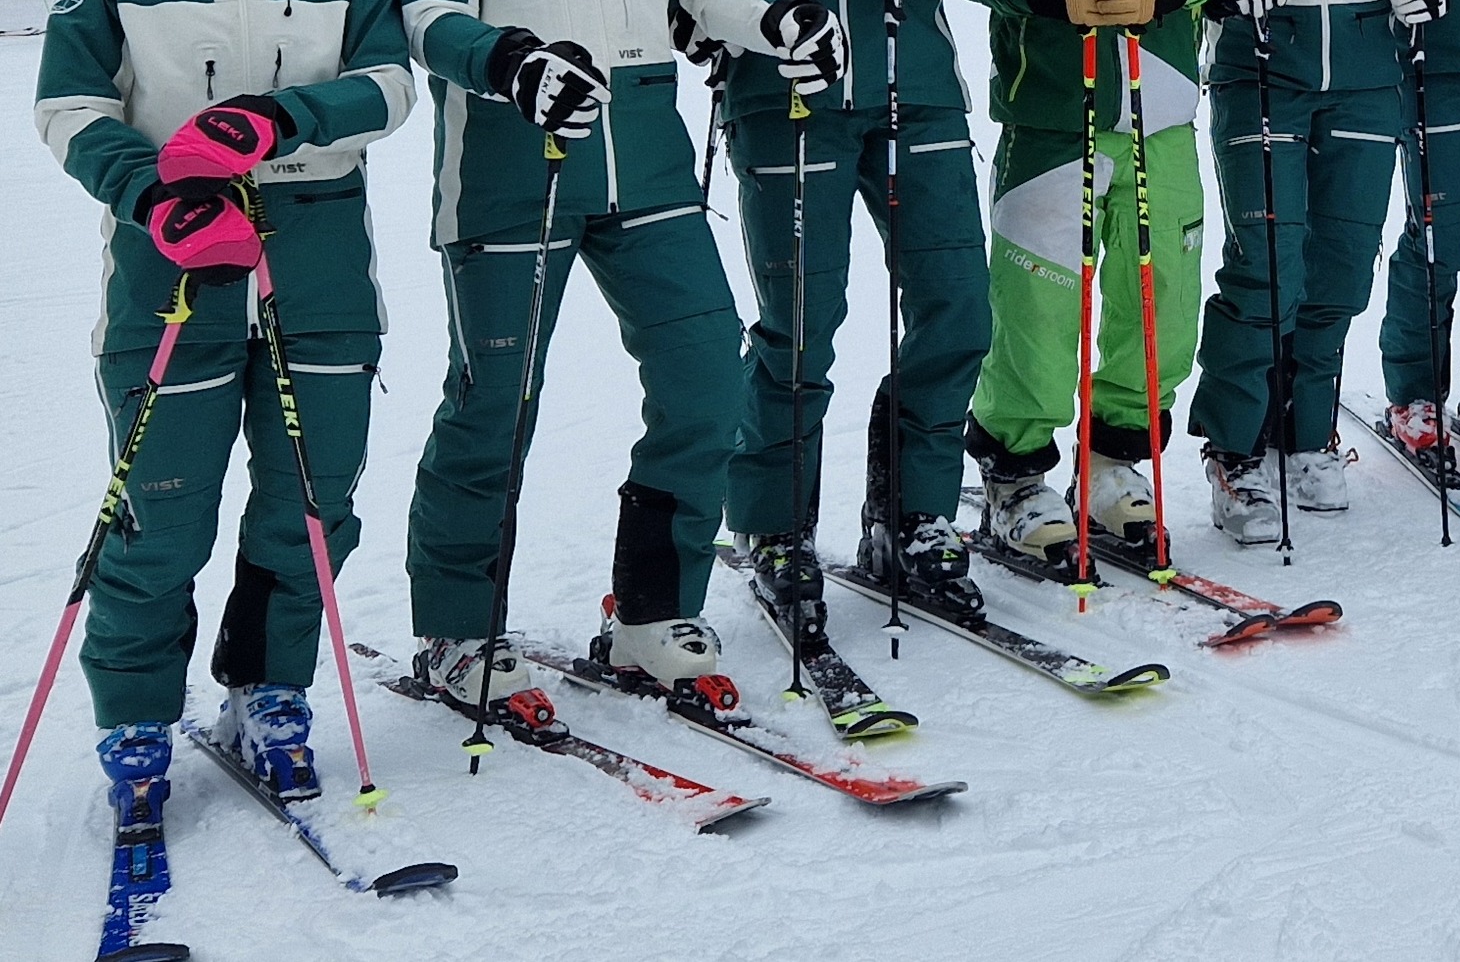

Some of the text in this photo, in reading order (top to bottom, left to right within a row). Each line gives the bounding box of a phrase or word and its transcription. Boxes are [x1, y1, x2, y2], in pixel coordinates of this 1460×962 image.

[207, 116, 245, 142] LEKI
[174, 202, 211, 230] LEKI
[793, 197, 804, 238] LEKI
[1082, 170, 1093, 227] LEKI
[1136, 171, 1149, 226] LEKI
[1004, 248, 1076, 291] ridersroom
[276, 376, 302, 438] LEKI
[101, 458, 131, 524] LEKI
